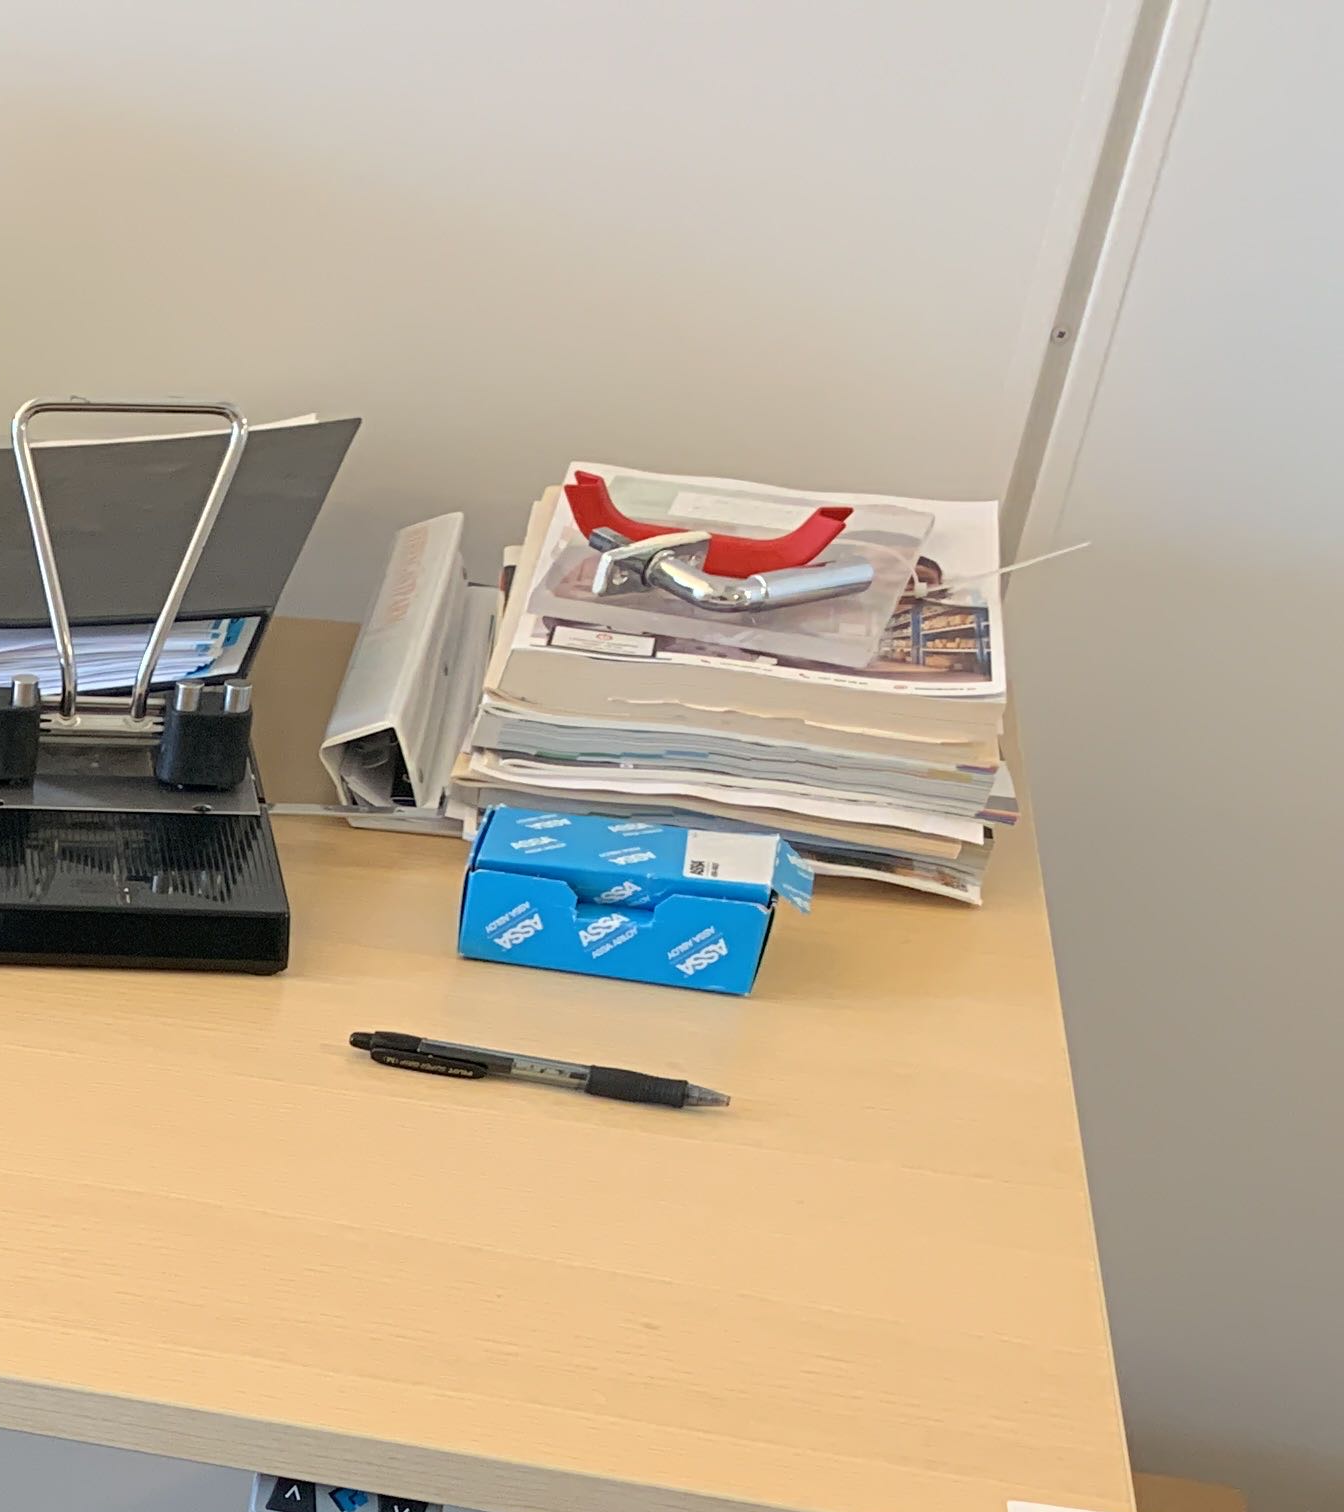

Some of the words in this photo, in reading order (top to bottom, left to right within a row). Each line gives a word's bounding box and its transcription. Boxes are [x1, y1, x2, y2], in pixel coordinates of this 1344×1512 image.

[493, 912, 544, 950] ASSA
[578, 913, 631, 947] ASSA
[675, 938, 729, 977] ASSA
